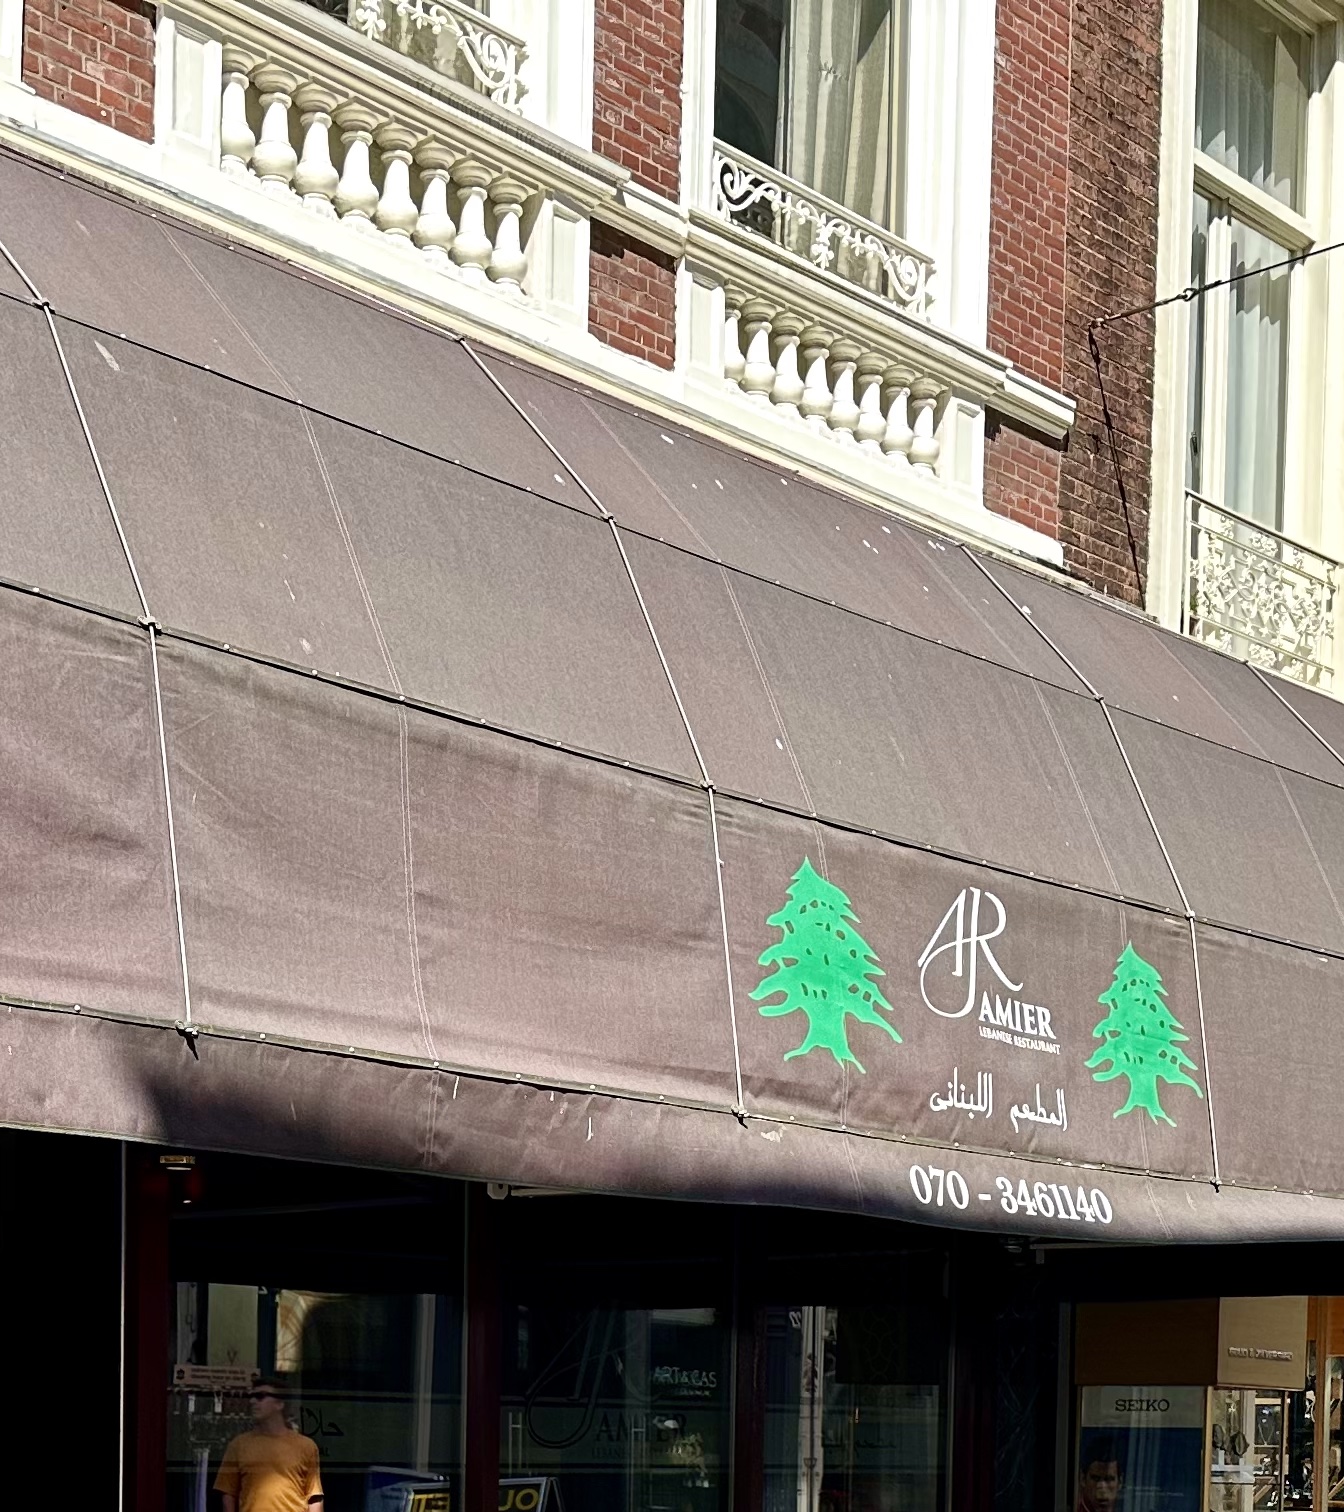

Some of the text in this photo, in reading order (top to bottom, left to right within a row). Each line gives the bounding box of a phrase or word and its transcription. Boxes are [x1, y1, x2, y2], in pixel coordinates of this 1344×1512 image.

[979, 991, 1057, 1040] AMIER
[979, 1025, 1061, 1056] LEBANESE RESTAURANT
[1010, 1083, 1068, 1132] المطعم
[909, 1165, 969, 1210] 070
[996, 1176, 1113, 1225] 3461140
[1115, 1399, 1170, 1412] SEIKO
